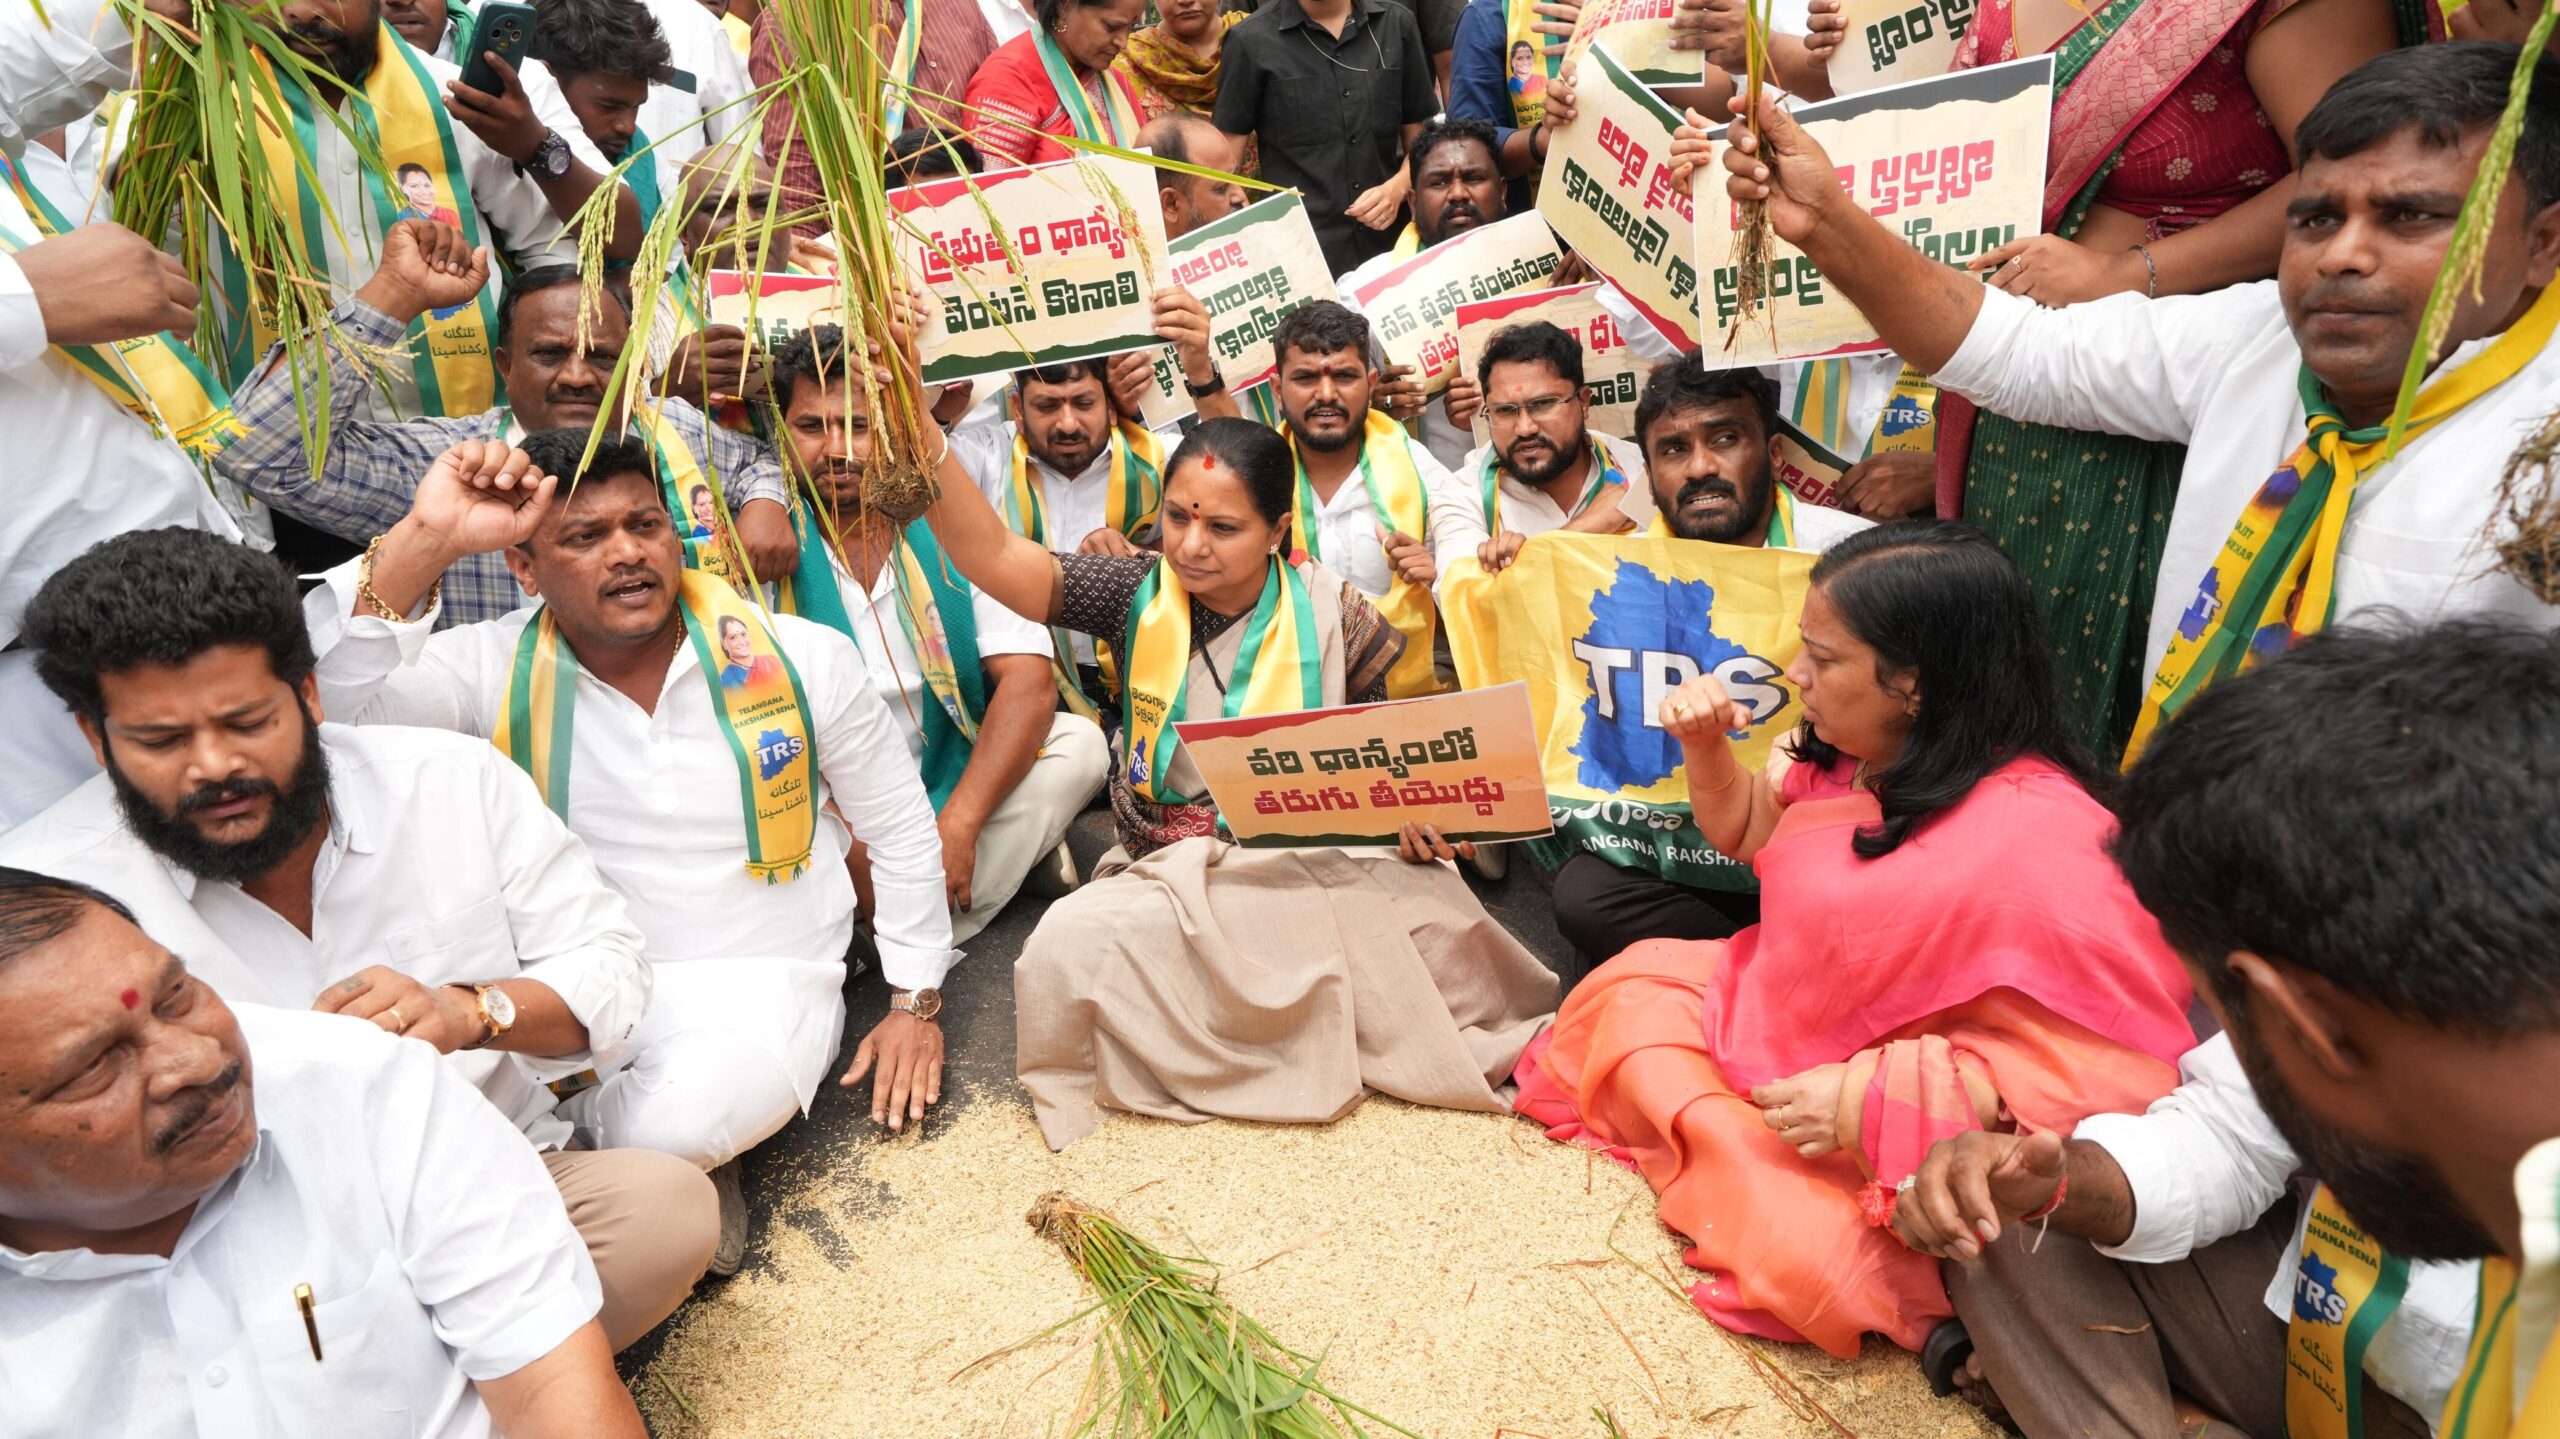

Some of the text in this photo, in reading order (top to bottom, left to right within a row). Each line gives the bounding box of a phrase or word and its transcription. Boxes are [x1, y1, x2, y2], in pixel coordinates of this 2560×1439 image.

[1866, 0, 1979, 72] న్యంలో
[1598, 117, 1648, 188] లేదా
[1870, 140, 1994, 217] బోనస్
[1562, 157, 1669, 268] ప్రాణాలకు
[920, 204, 1139, 284] ప్రభుత్వం ధాన్యం
[942, 270, 1140, 334] వెంటనే కొనాలి
[1200, 265, 1292, 318] కేటాయిం
[1380, 304, 1418, 342] సన్
[1470, 252, 1561, 302] పంటనంతా
[1215, 295, 1314, 359] వులకు
[1417, 332, 1459, 378] ప్రభు
[1584, 371, 1638, 407] చాలి
[1882, 408, 1932, 425] TRS
[738, 696, 785, 716] TELANGANA
[1572, 637, 1790, 730] TRS
[734, 703, 796, 729] RAKSHANA SENA
[754, 736, 805, 766] TRS
[1130, 749, 1149, 781] TRS
[1246, 726, 1478, 779] వరి ధాన్యంలో
[1254, 776, 1505, 816] తరుగు తీయొద్దు
[1582, 835, 1745, 876] ANGANA RAKSH
[2307, 1223, 2378, 1270] SHANA SENA
[2310, 1207, 2366, 1245] LANGANA
[2295, 1268, 2348, 1324] TRS
